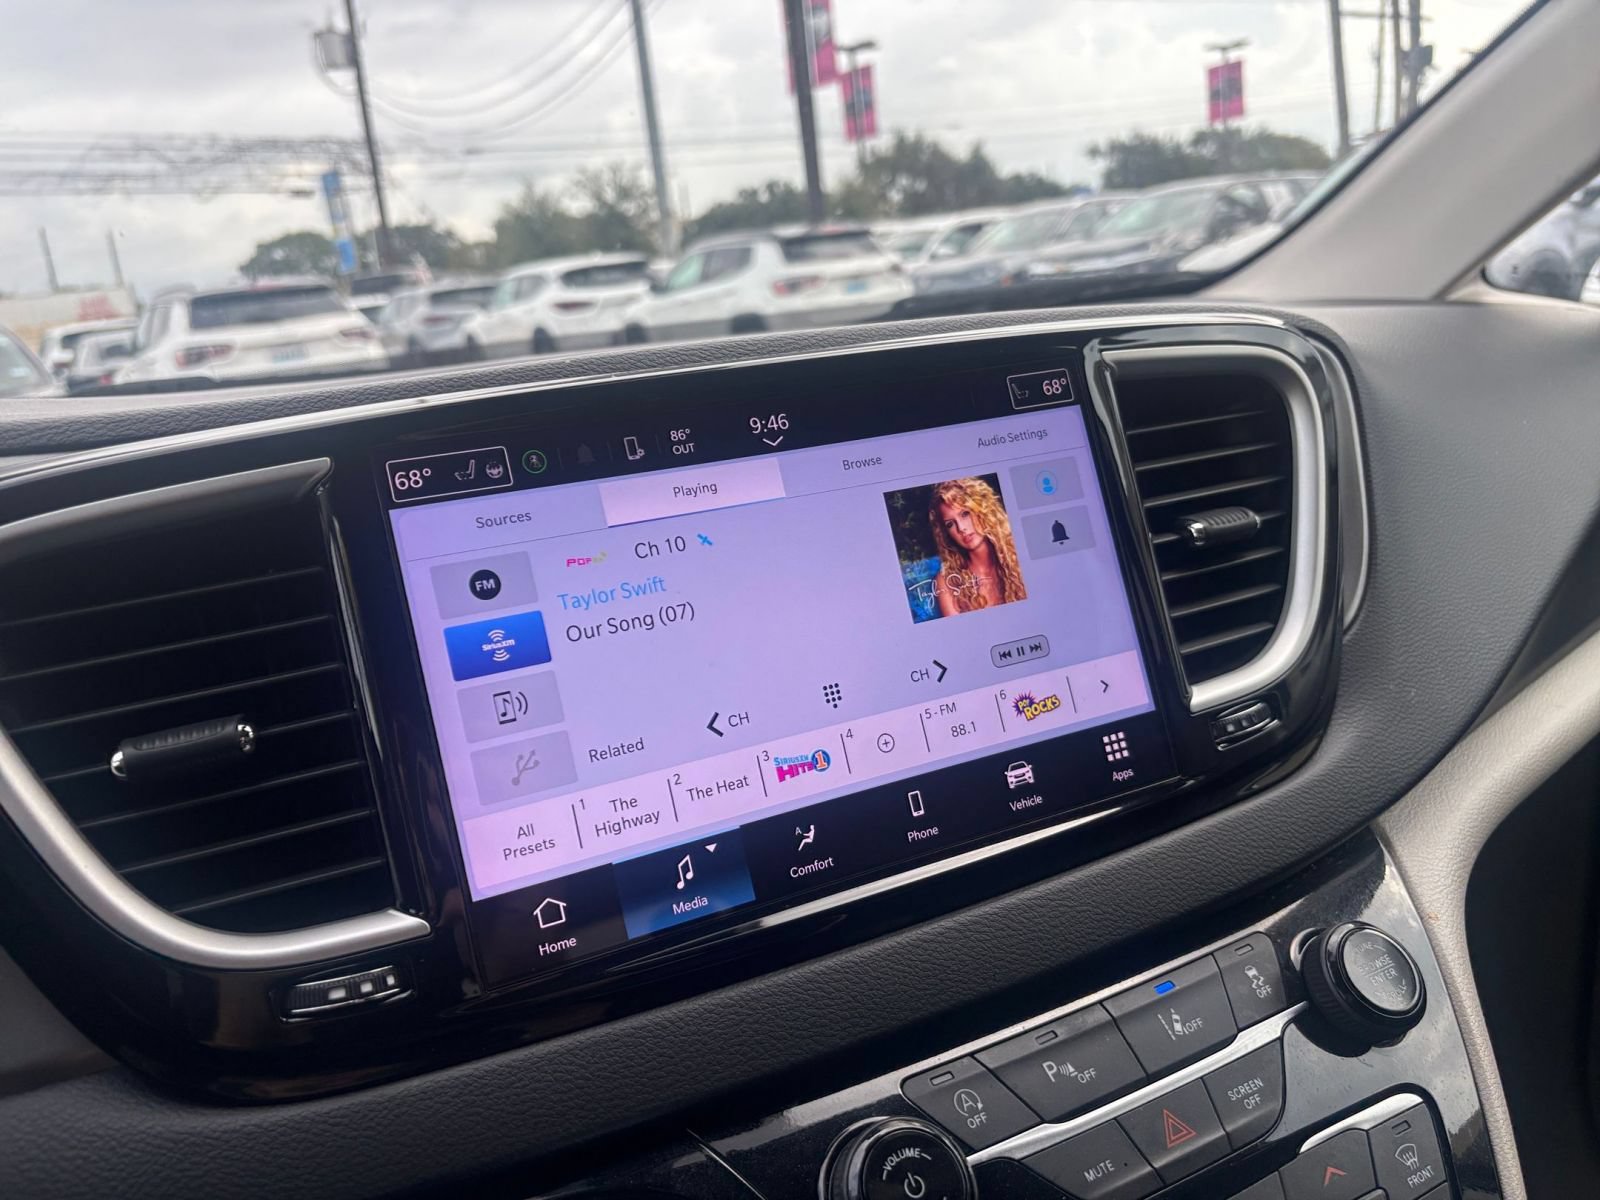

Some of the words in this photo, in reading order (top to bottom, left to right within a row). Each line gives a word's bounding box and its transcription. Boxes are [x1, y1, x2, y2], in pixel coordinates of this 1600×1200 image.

[1042, 378, 1067, 396] 68°
[749, 413, 789, 434] 9:46
[670, 428, 690, 441] 86°
[977, 434, 1006, 448] Audio
[1007, 428, 1048, 445] Settings
[672, 443, 695, 455] OUT
[842, 455, 882, 471] Browse
[394, 468, 432, 490] 68°
[673, 482, 718, 498] Playing
[475, 511, 532, 529] Sources
[634, 541, 660, 559] Ch
[665, 536, 686, 553] 10
[475, 578, 496, 592] FM
[557, 588, 616, 611] Taylor
[620, 576, 667, 599] Swift
[566, 624, 602, 642] Our
[606, 613, 655, 635] Song
[658, 601, 695, 627] (07)
[910, 668, 930, 682] CH
[999, 689, 1007, 700] 6
[924, 707, 932, 719] 5
[939, 701, 957, 716] FM
[1023, 694, 1061, 721] ROCKS
[727, 710, 751, 728] CH
[845, 728, 854, 740] 4
[950, 720, 977, 738] 88.1
[588, 737, 645, 763] Related
[761, 750, 770, 762] 3
[672, 773, 683, 786] 2
[1111, 767, 1135, 782] Apps
[686, 786, 714, 803] The
[715, 774, 750, 796] Heat
[578, 798, 587, 811] 1
[608, 795, 639, 814] The
[1009, 794, 1043, 812] Vehicle
[516, 823, 536, 841] All
[594, 810, 662, 838] Highway
[907, 824, 940, 843] Phone
[502, 836, 557, 861] Presets
[789, 856, 835, 878] Comfort
[672, 894, 709, 915] Media
[538, 935, 578, 956] Home
[1370, 967, 1398, 986] ENTER
[1256, 984, 1273, 999] OFF
[1185, 1016, 1204, 1034] OFF
[1042, 1060, 1058, 1083] P
[1077, 1067, 1097, 1084] OFF
[1227, 1077, 1264, 1101] SCREEN
[1243, 1093, 1262, 1110] OFF
[967, 1112, 988, 1129] OFF
[882, 1147, 921, 1172] VOLUME
[1083, 1159, 1115, 1183] MUTE
[1407, 1165, 1435, 1189] FRONT
